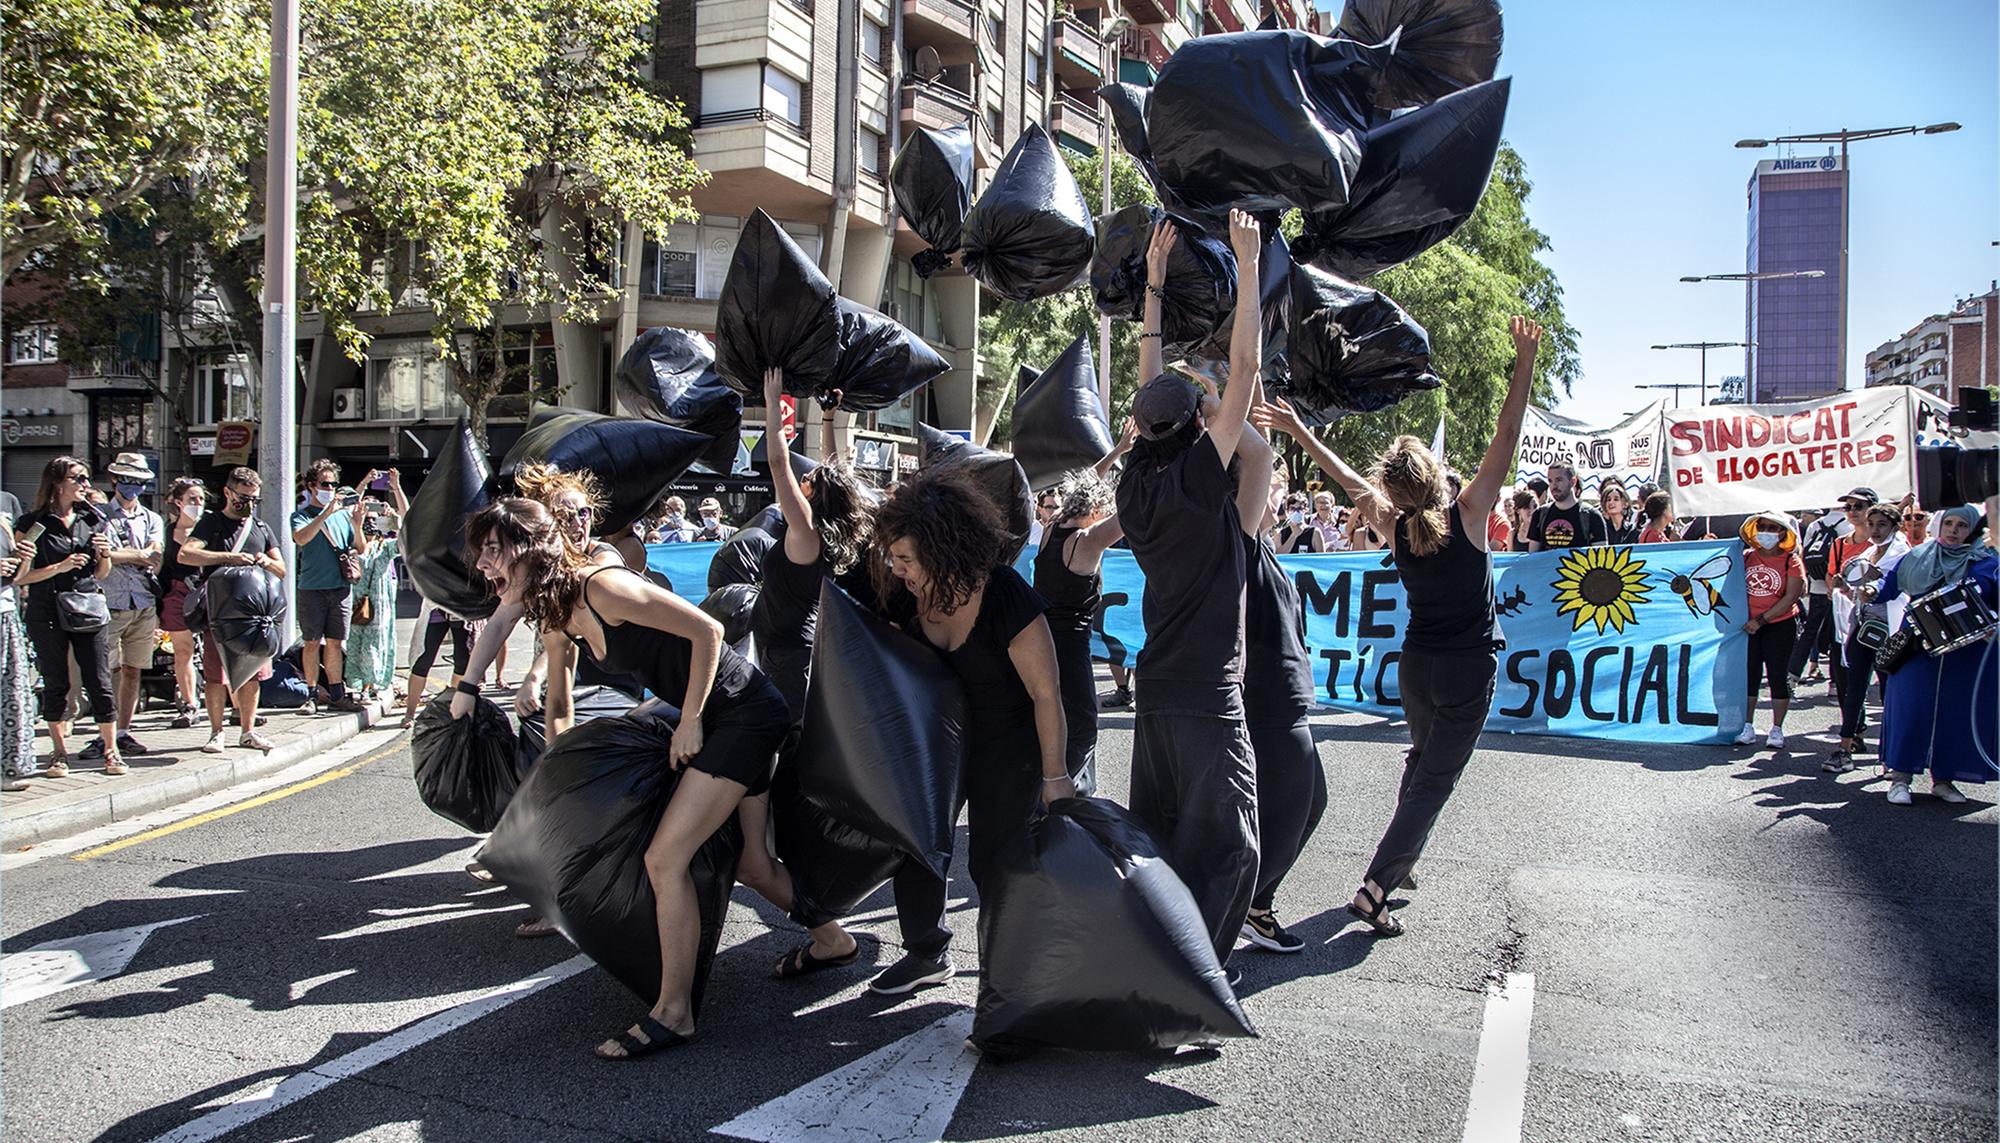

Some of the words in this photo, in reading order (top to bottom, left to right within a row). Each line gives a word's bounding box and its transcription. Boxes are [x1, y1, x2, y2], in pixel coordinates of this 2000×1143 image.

[1773, 159, 1817, 170] Allianz
[662, 252, 690, 262] CODE
[1669, 402, 1857, 457] SINDICAT
[1631, 437, 1649, 449] NUS
[1519, 449, 1573, 466] ACIONS
[1676, 467, 1703, 487] DE
[1716, 434, 1897, 483] LLOGATERES
[1499, 644, 1719, 727] SOCIAL
